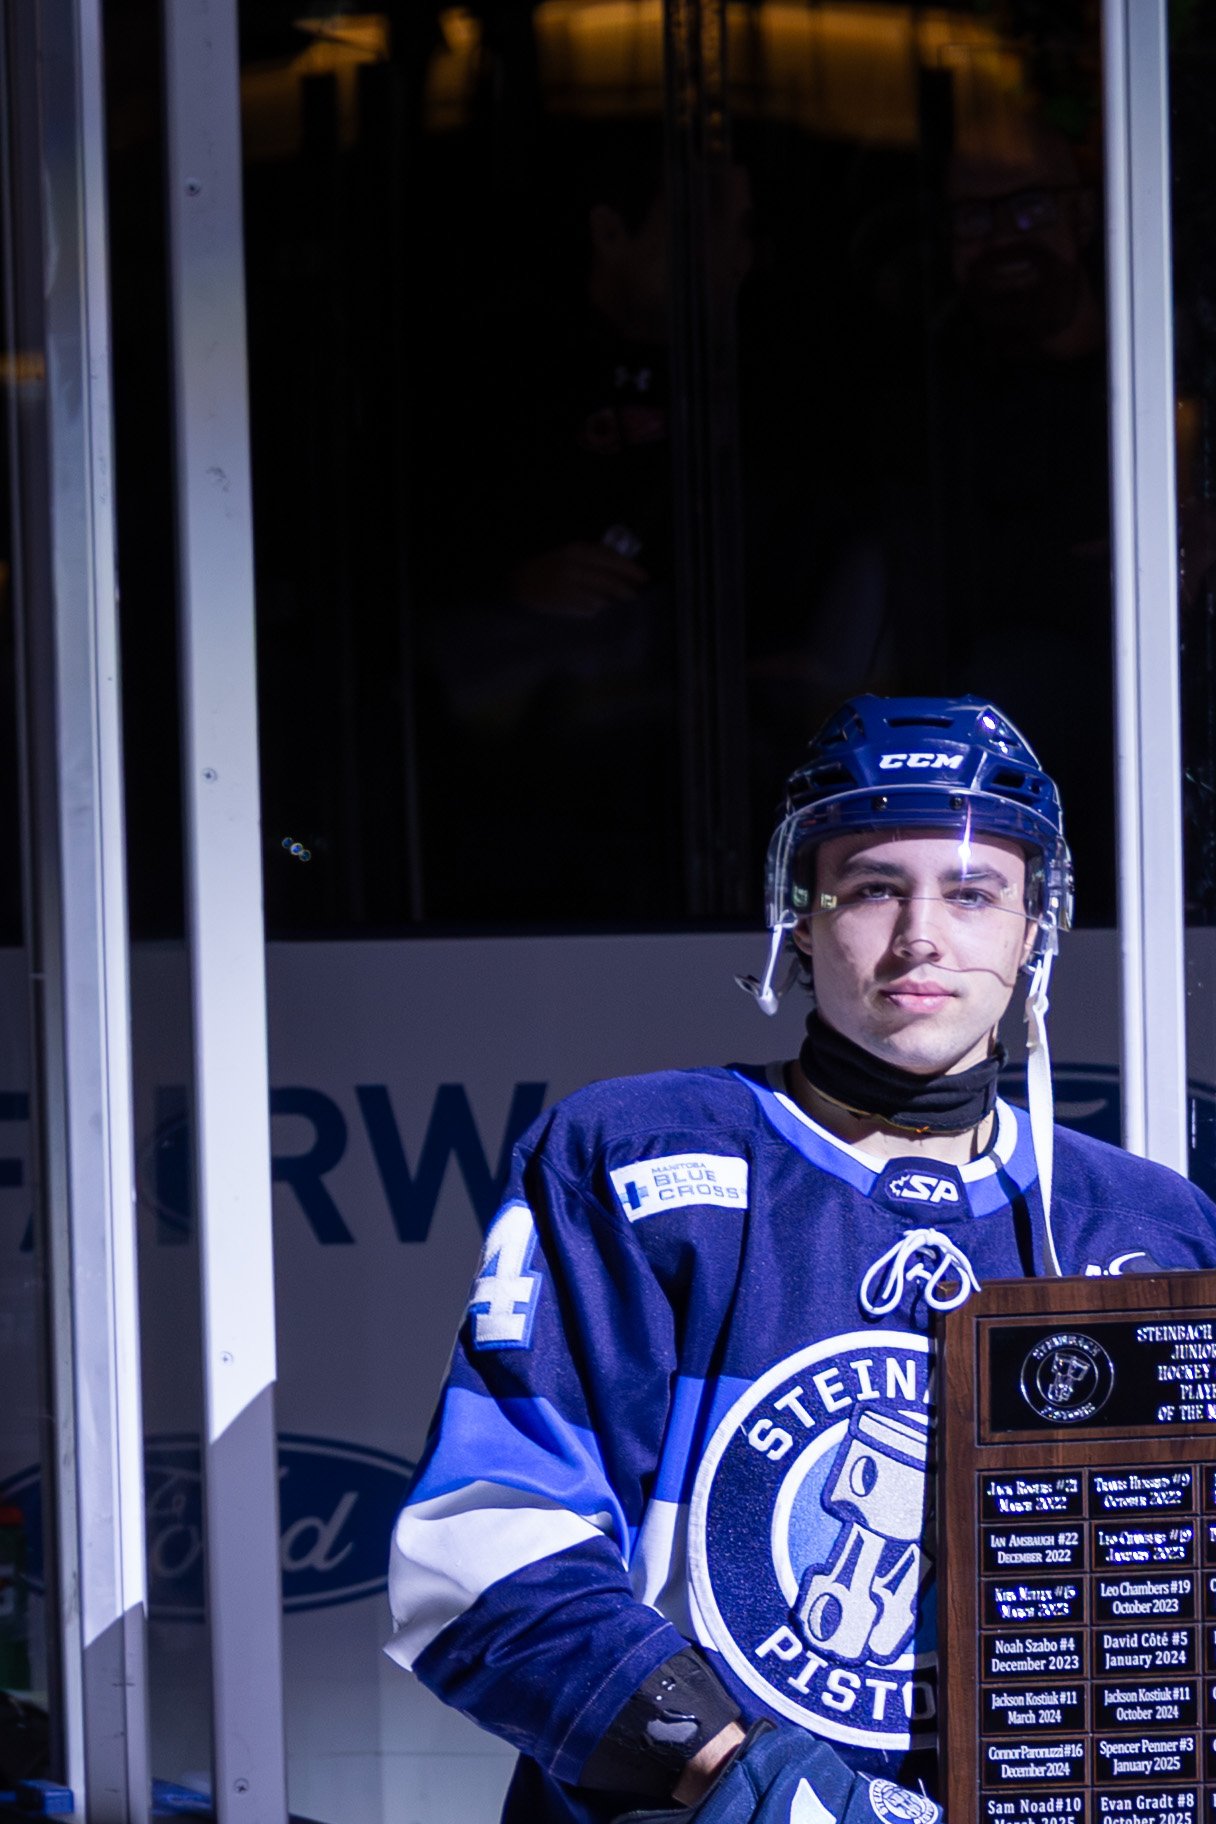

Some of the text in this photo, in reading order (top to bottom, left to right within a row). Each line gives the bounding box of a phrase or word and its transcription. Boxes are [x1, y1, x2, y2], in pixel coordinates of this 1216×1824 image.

[879, 753, 965, 770] CCM
[654, 1168, 718, 1188] BLUE
[658, 1184, 741, 1202] CROSS
[469, 1202, 537, 1345] 4
[1137, 1325, 1212, 1343] STEINBACH
[1158, 1364, 1211, 1380] HOCKEY
[748, 1356, 931, 1461] STEIN
[1158, 1406, 1174, 1421] OF
[1179, 1404, 1202, 1419] THE
[1058, 1532, 1078, 1545] #22
[1045, 1549, 1071, 1562] 2022
[1101, 1580, 1191, 1597] Leo Chambers #19
[1113, 1599, 1178, 1614] October 2023
[995, 1638, 1074, 1654] Noah Szabo #4
[1104, 1632, 1187, 1649] David Côté #5
[991, 1656, 1079, 1672] December 2023
[1105, 1651, 1186, 1668] January 2024
[992, 1691, 1077, 1708] Jackson Kostiuk #11
[1104, 1687, 1190, 1704] Jackson Kostiuk #11
[1008, 1709, 1062, 1724] March 2024
[1116, 1706, 1179, 1721] October 2024
[988, 1744, 1083, 1760] Connor Paronuzzi #16
[1100, 1737, 1193, 1757] Spencer Penner #3
[1002, 1762, 1070, 1778] December 2024
[1113, 1757, 1180, 1774] January 2025
[988, 1801, 1015, 1815] Sam
[1101, 1793, 1194, 1811] Evan Gradt #8
